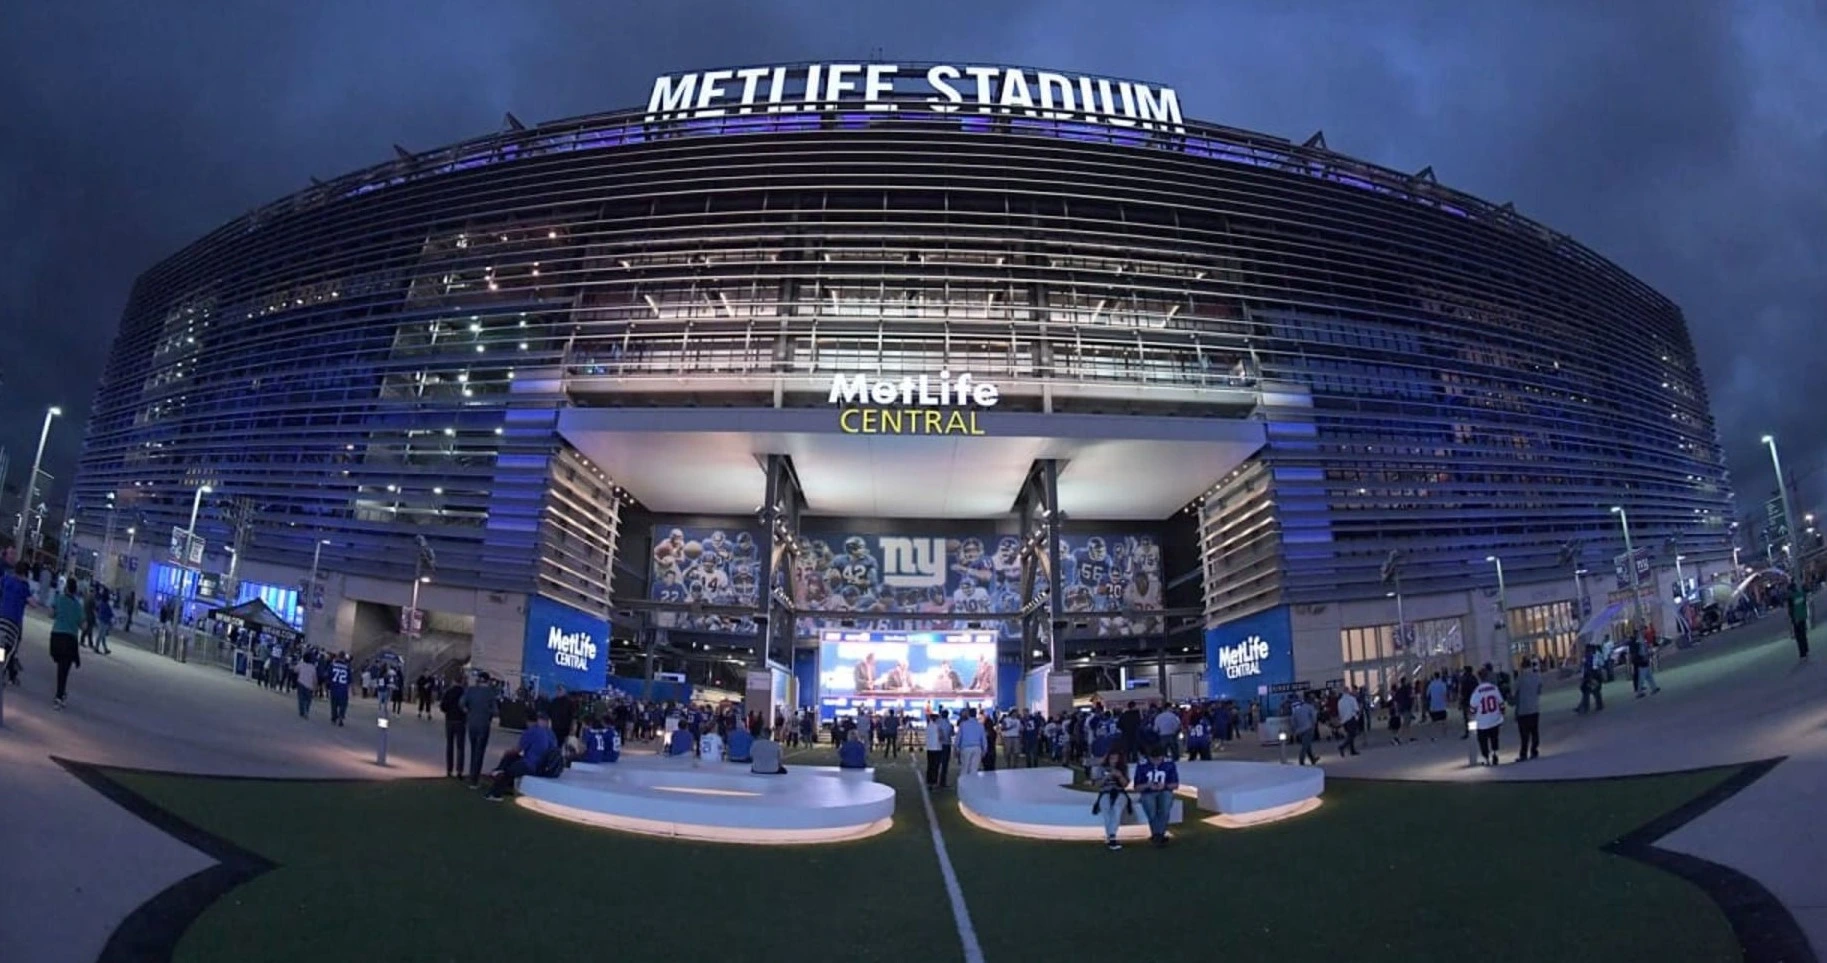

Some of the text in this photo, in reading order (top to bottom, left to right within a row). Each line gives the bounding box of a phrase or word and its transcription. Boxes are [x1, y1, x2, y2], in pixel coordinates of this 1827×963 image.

[645, 63, 1185, 135] METLIFE STADIUM
[828, 370, 999, 406] MetLife
[840, 408, 986, 435] CENTRAL
[879, 537, 947, 587] ny
[1081, 562, 1105, 582] 56
[841, 564, 866, 585] 42
[547, 625, 597, 660] MetLife
[1219, 635, 1269, 670] MetLife
[555, 651, 589, 671] CENTRAL
[1226, 659, 1262, 680] CENTRAL
[332, 668, 348, 684] 72
[1480, 695, 1498, 715] 10
